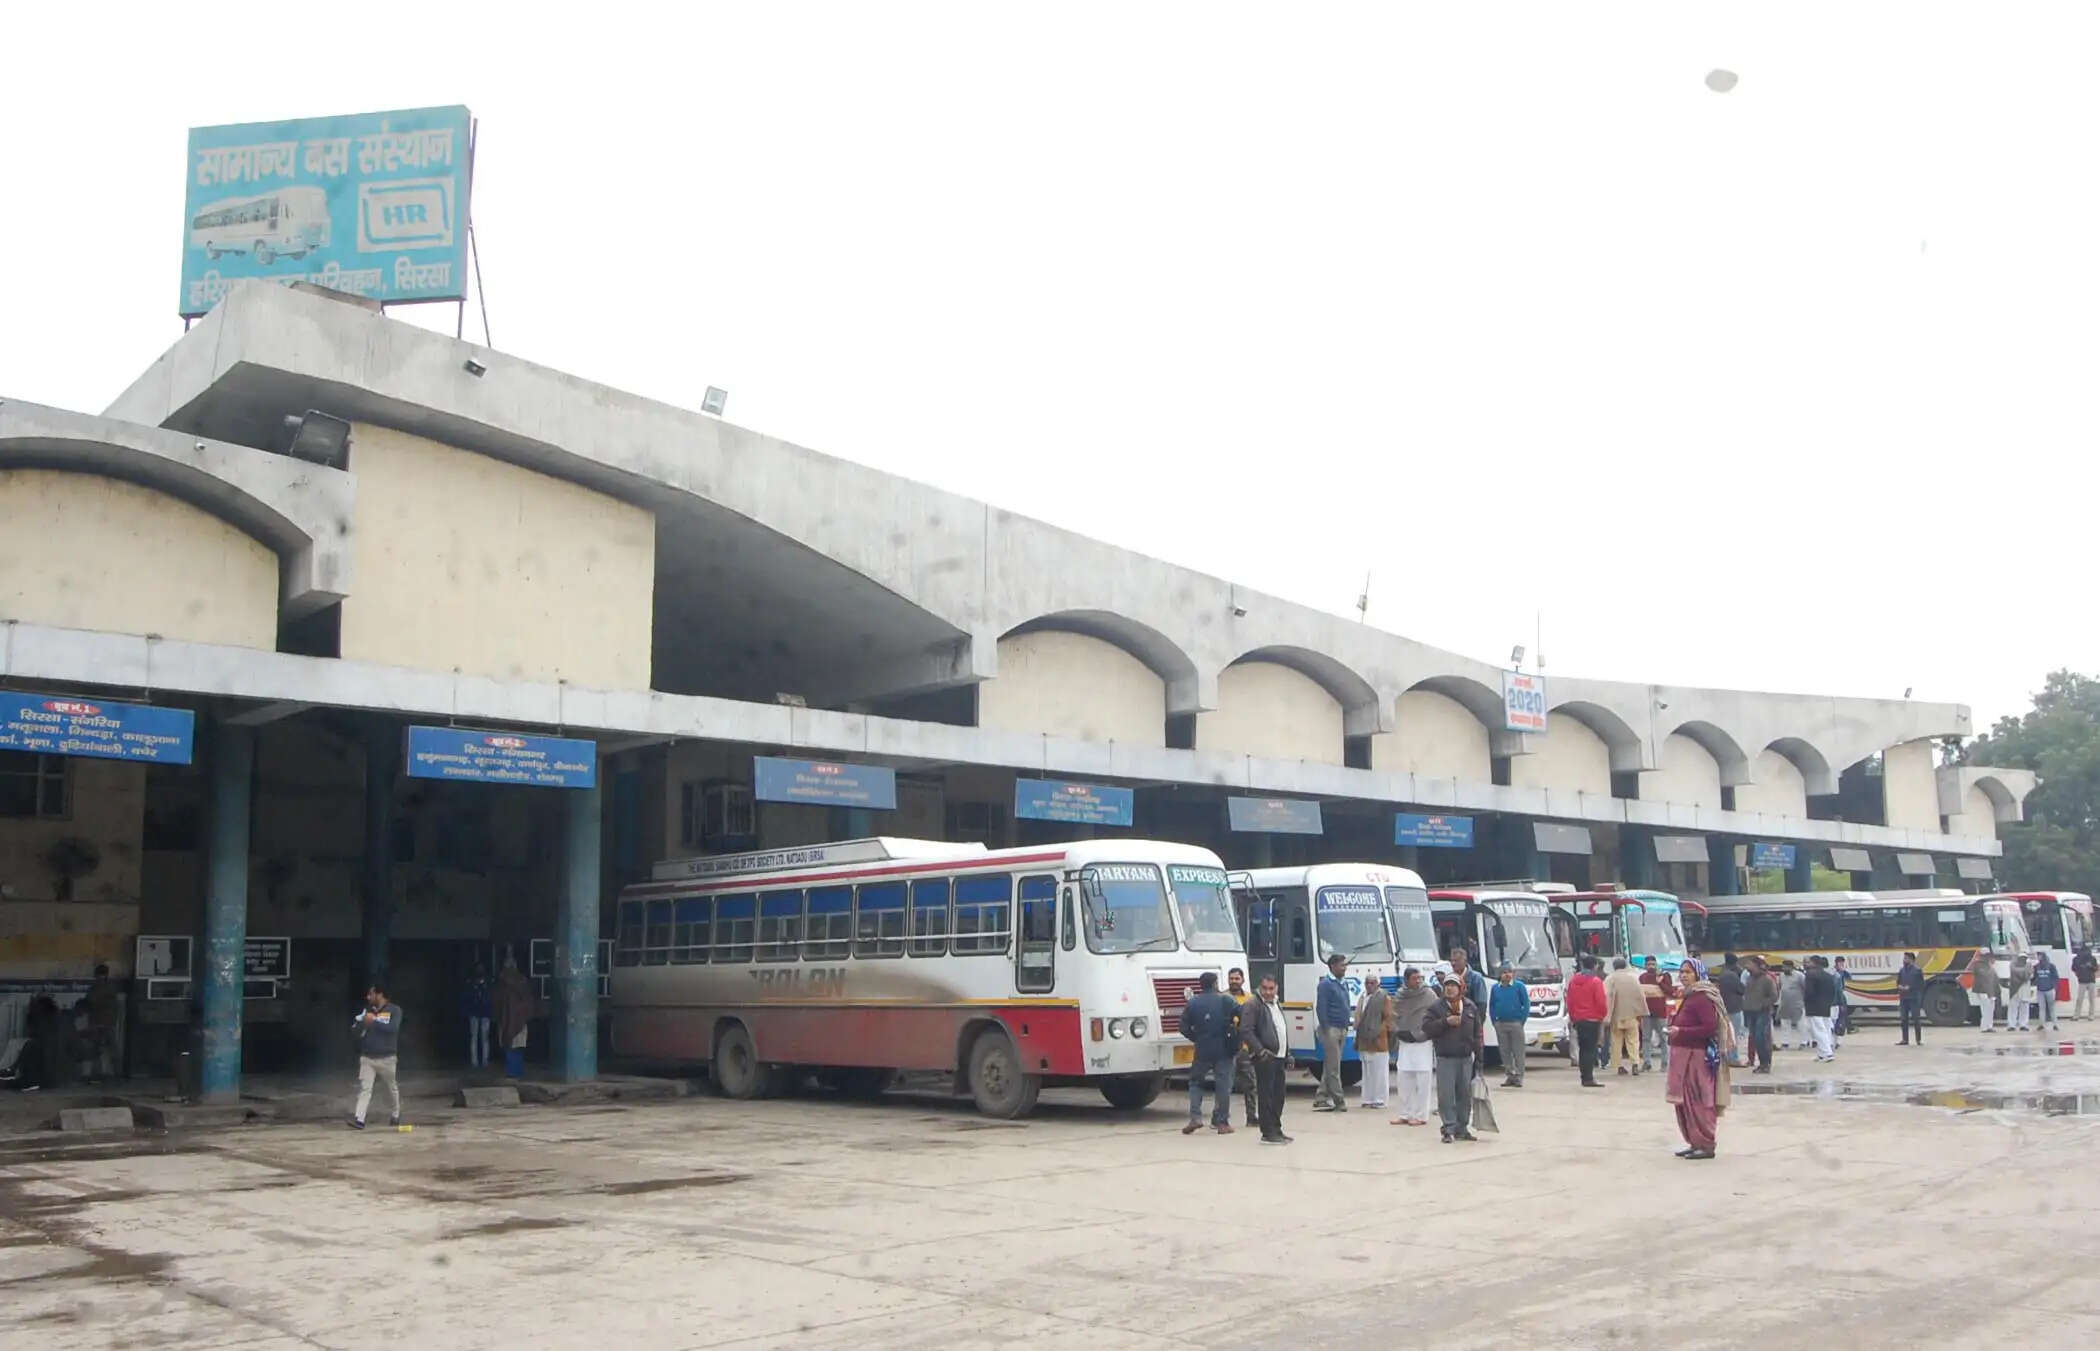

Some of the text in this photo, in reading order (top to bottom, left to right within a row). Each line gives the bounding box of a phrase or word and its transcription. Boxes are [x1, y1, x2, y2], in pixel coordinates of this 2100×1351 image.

[196, 141, 298, 186] सामान्य
[302, 137, 351, 178] बस
[382, 201, 428, 227] HR
[394, 256, 452, 291] सिरसा
[1507, 687, 1543, 714] 2020
[20, 708, 61, 722] सिरसा
[1323, 892, 1377, 905] WELCOME
